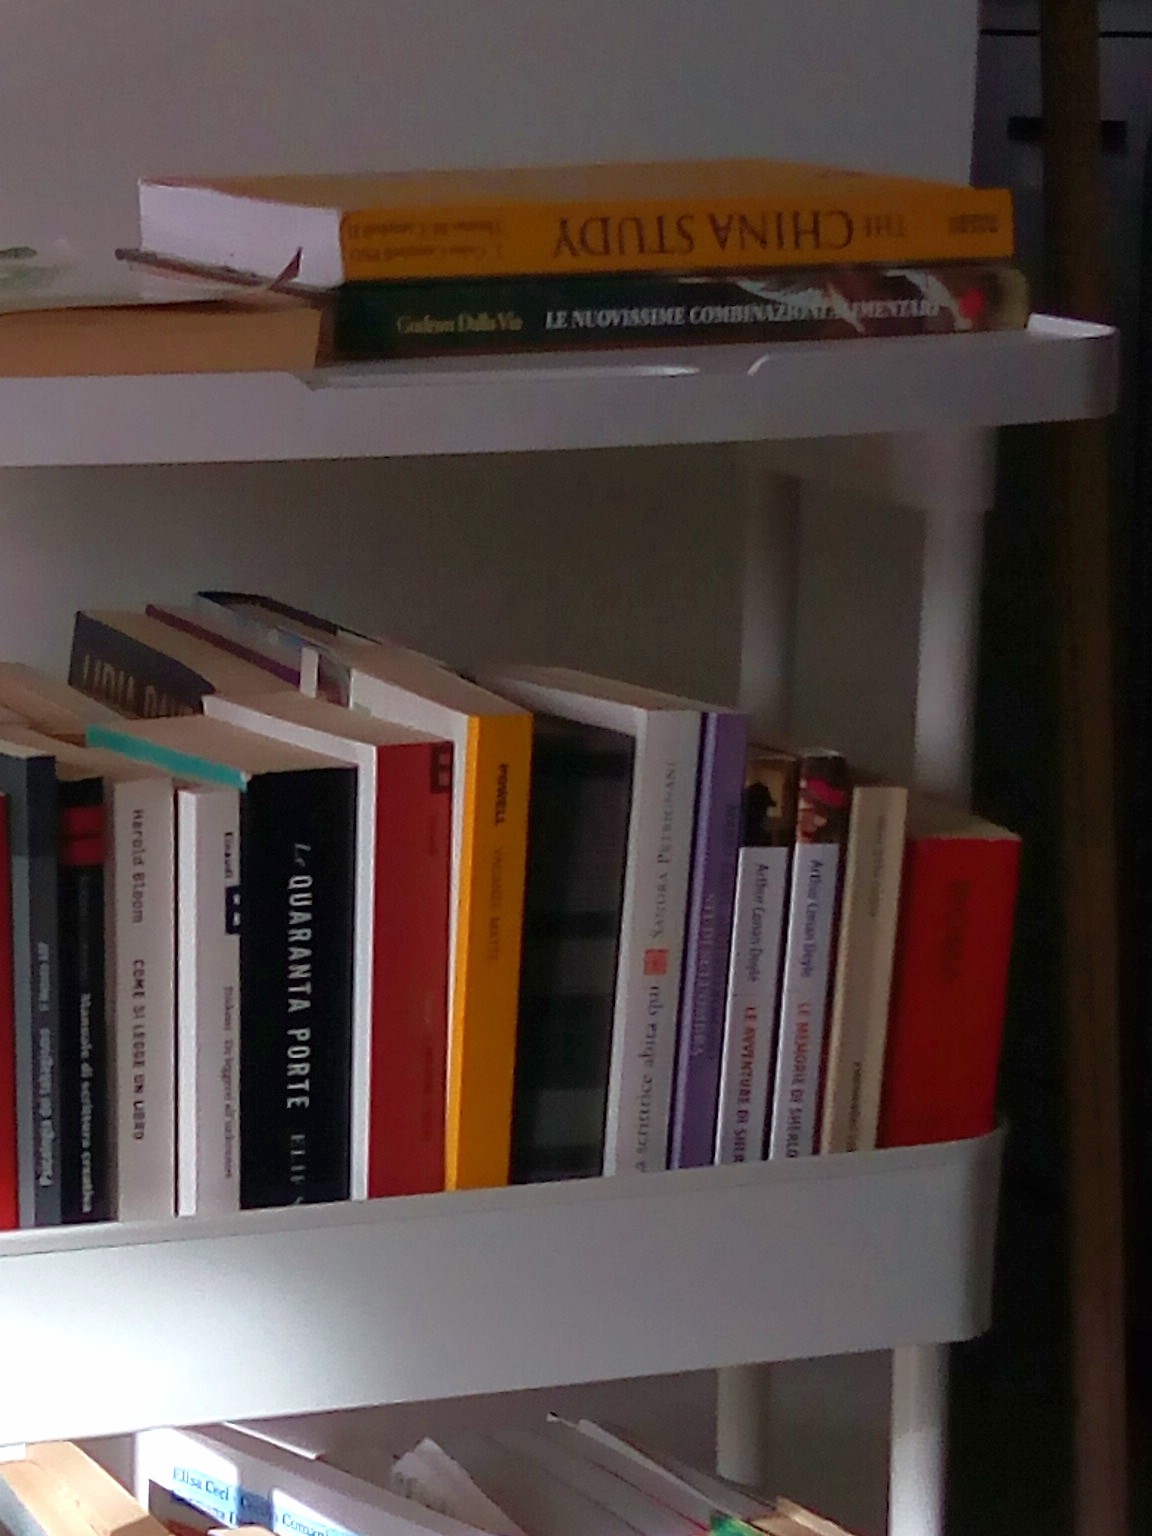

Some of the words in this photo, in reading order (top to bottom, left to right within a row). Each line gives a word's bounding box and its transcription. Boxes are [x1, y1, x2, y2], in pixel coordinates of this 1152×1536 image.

[553, 213, 695, 257] STUDY
[708, 209, 855, 251] CHINA
[865, 215, 908, 238] THE
[545, 310, 569, 330] LE
[570, 307, 687, 329] NUOVISSIME
[689, 302, 827, 325] COMBINAZIONI
[494, 763, 509, 827] POWELL
[132, 808, 145, 867] Harold
[132, 872, 146, 924] Bloom
[750, 906, 766, 946] Conan
[803, 901, 820, 941] Conan
[287, 874, 314, 1013] QUARANTA
[747, 947, 764, 983] Doyle
[800, 942, 817, 979] Doyle
[132, 958, 145, 1000] COME
[638, 1022, 657, 1060] abita
[649, 985, 664, 1017] qui
[286, 1027, 312, 1109] PORTE
[737, 1026, 756, 1105] AVVENTURE
[792, 1021, 810, 1085] MEMORIE
[734, 1109, 749, 1124] DI
[790, 1088, 804, 1104] DI
[733, 1128, 748, 1163] SHER
[786, 1107, 803, 1158] SHERLO
[290, 1134, 307, 1183] ELIF
